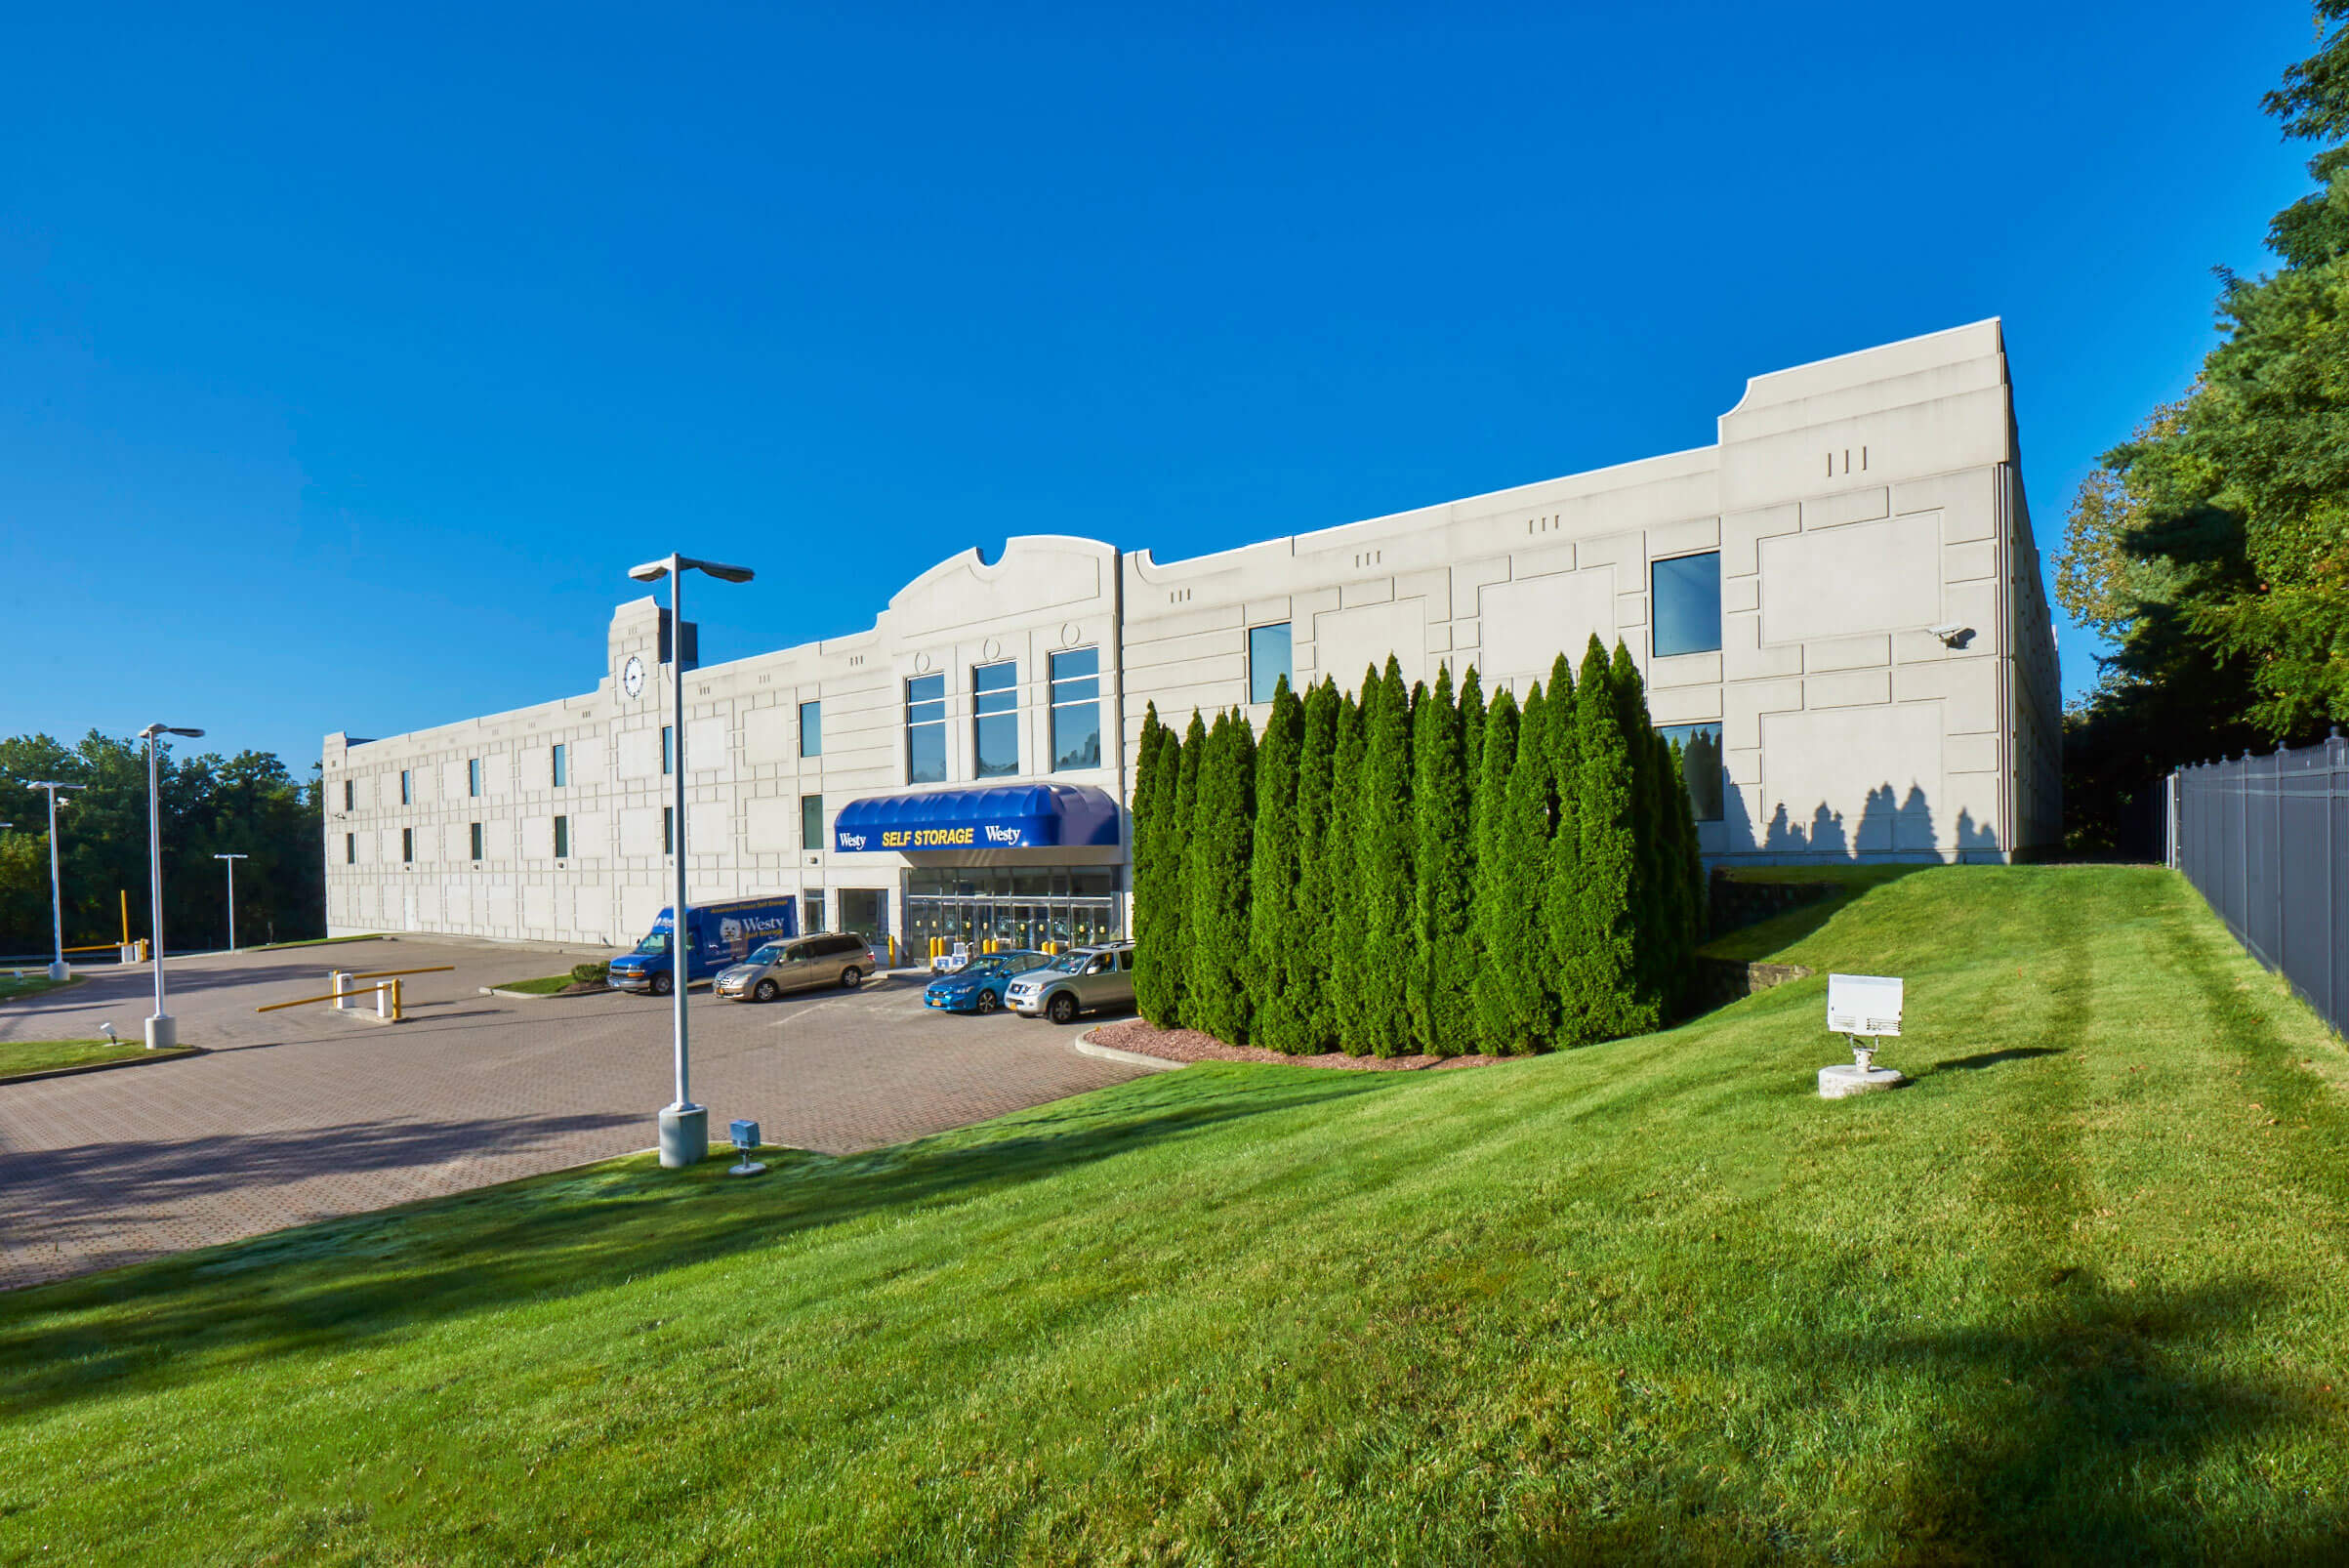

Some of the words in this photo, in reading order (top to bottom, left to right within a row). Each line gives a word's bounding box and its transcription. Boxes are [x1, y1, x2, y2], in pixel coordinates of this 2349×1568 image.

[840, 832, 866, 850] Westy
[882, 831, 912, 847] SELF
[914, 828, 974, 846] STORAGE
[984, 825, 1021, 846] Westy
[742, 917, 785, 935] Westy
